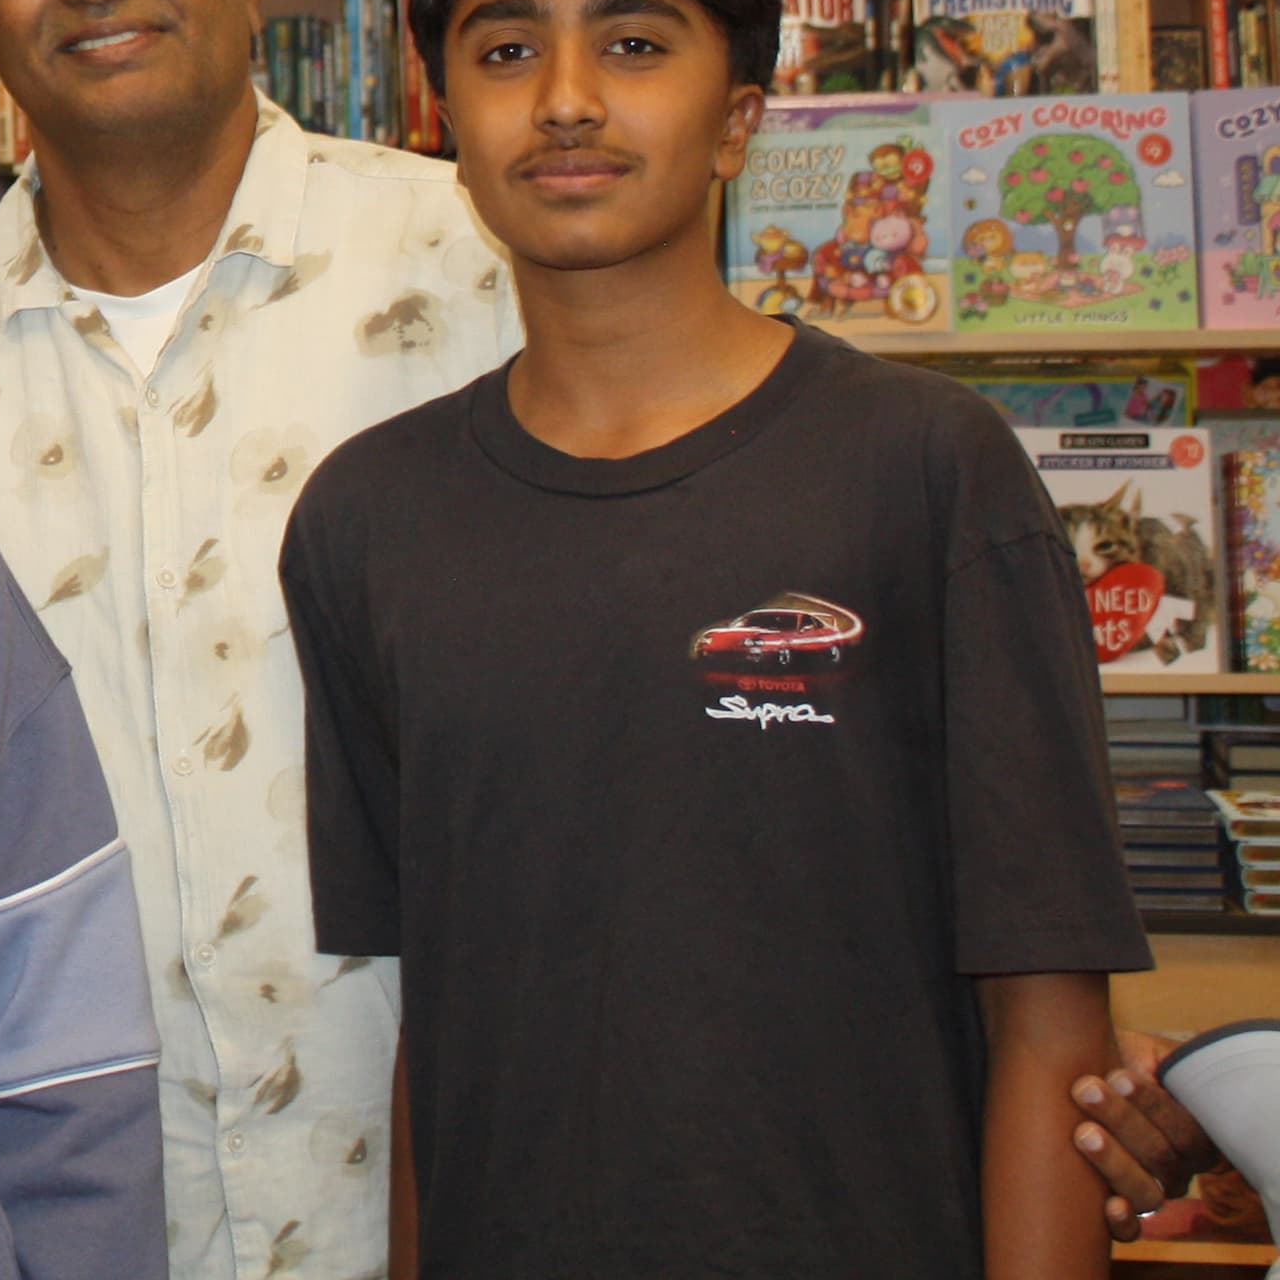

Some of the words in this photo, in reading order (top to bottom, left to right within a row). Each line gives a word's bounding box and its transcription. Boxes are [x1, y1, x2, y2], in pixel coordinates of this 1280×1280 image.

[958, 111, 1023, 149] COZY
[1031, 102, 1168, 140] COLORING
[1218, 101, 1280, 139] COZY
[749, 144, 845, 175] COMFY
[770, 172, 843, 202] COZY
[1095, 586, 1152, 615] NEED
[758, 680, 806, 692] TOYOTA
[705, 694, 836, 730] Supra
